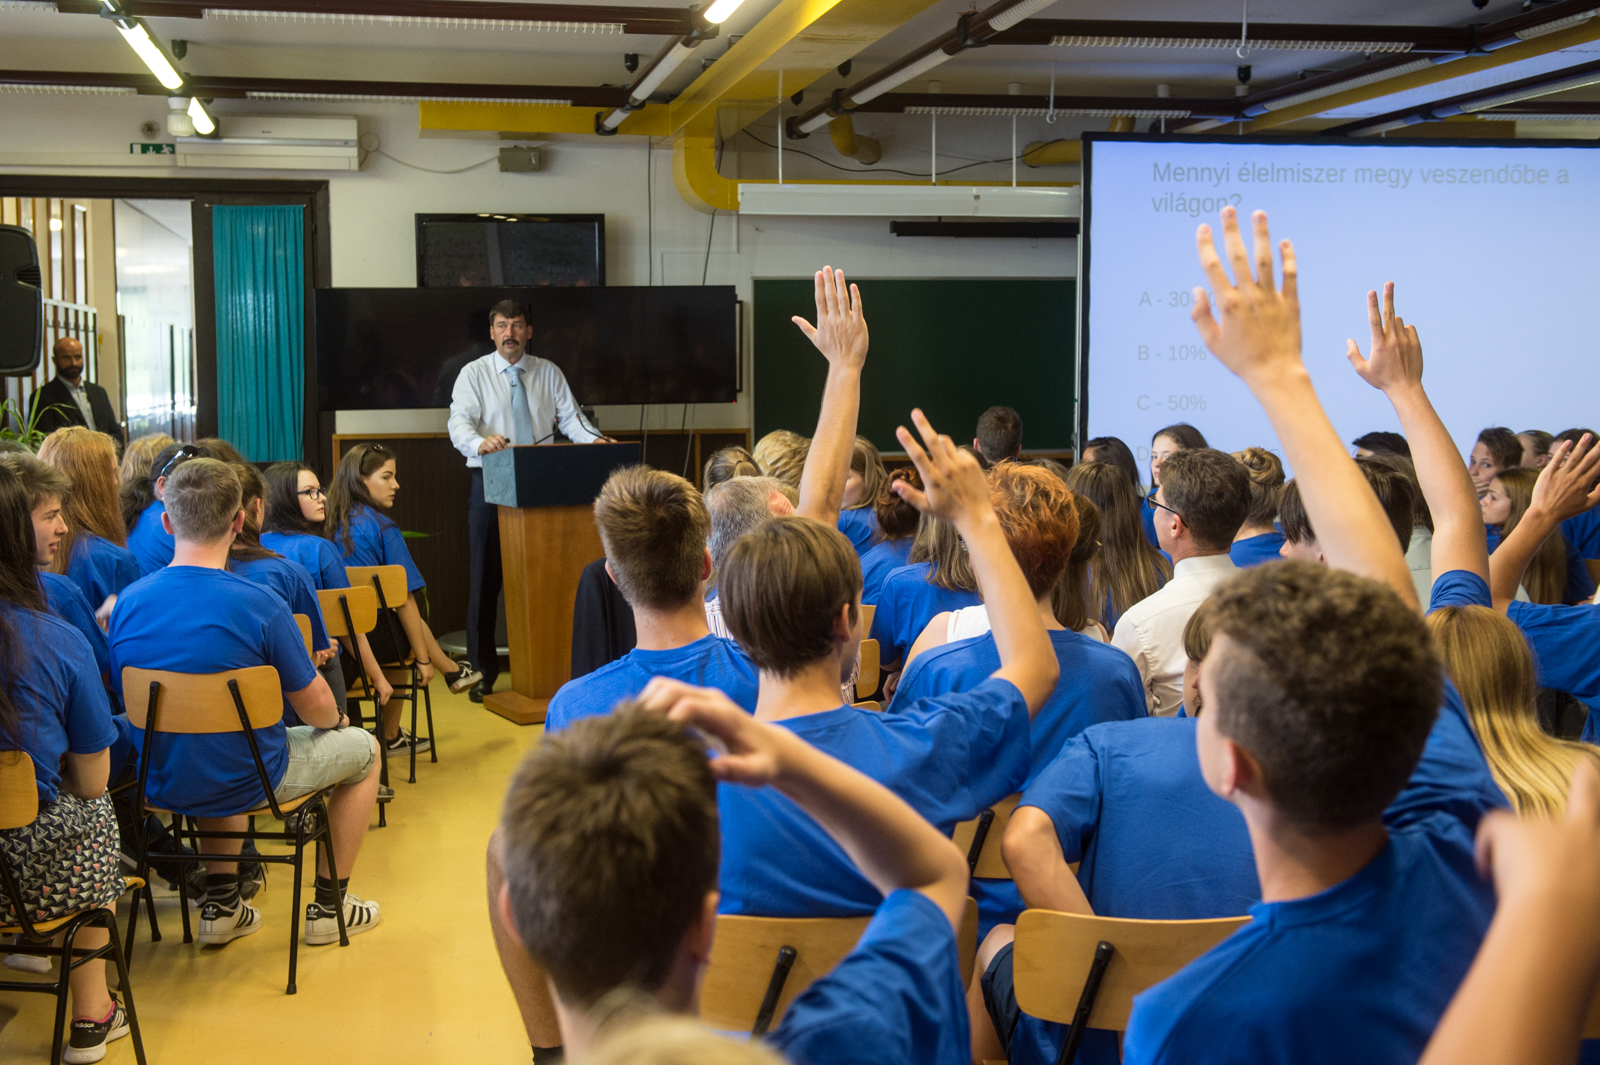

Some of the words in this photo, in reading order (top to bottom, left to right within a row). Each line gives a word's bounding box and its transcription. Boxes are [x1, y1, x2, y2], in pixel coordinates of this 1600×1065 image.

[1153, 162, 1230, 188] Mennyi
[1238, 162, 1347, 183] élelmiszer
[1355, 167, 1413, 189] megy
[1420, 164, 1549, 185] veszendőbe
[1556, 168, 1570, 184] a
[1151, 192, 1242, 218] világon?
[1139, 291, 1152, 307] A
[1138, 345, 1149, 361] B
[1168, 345, 1207, 361] 10%
[1137, 395, 1150, 411] C
[1168, 395, 1207, 411] 50%
[1137, 446, 1149, 461] D
